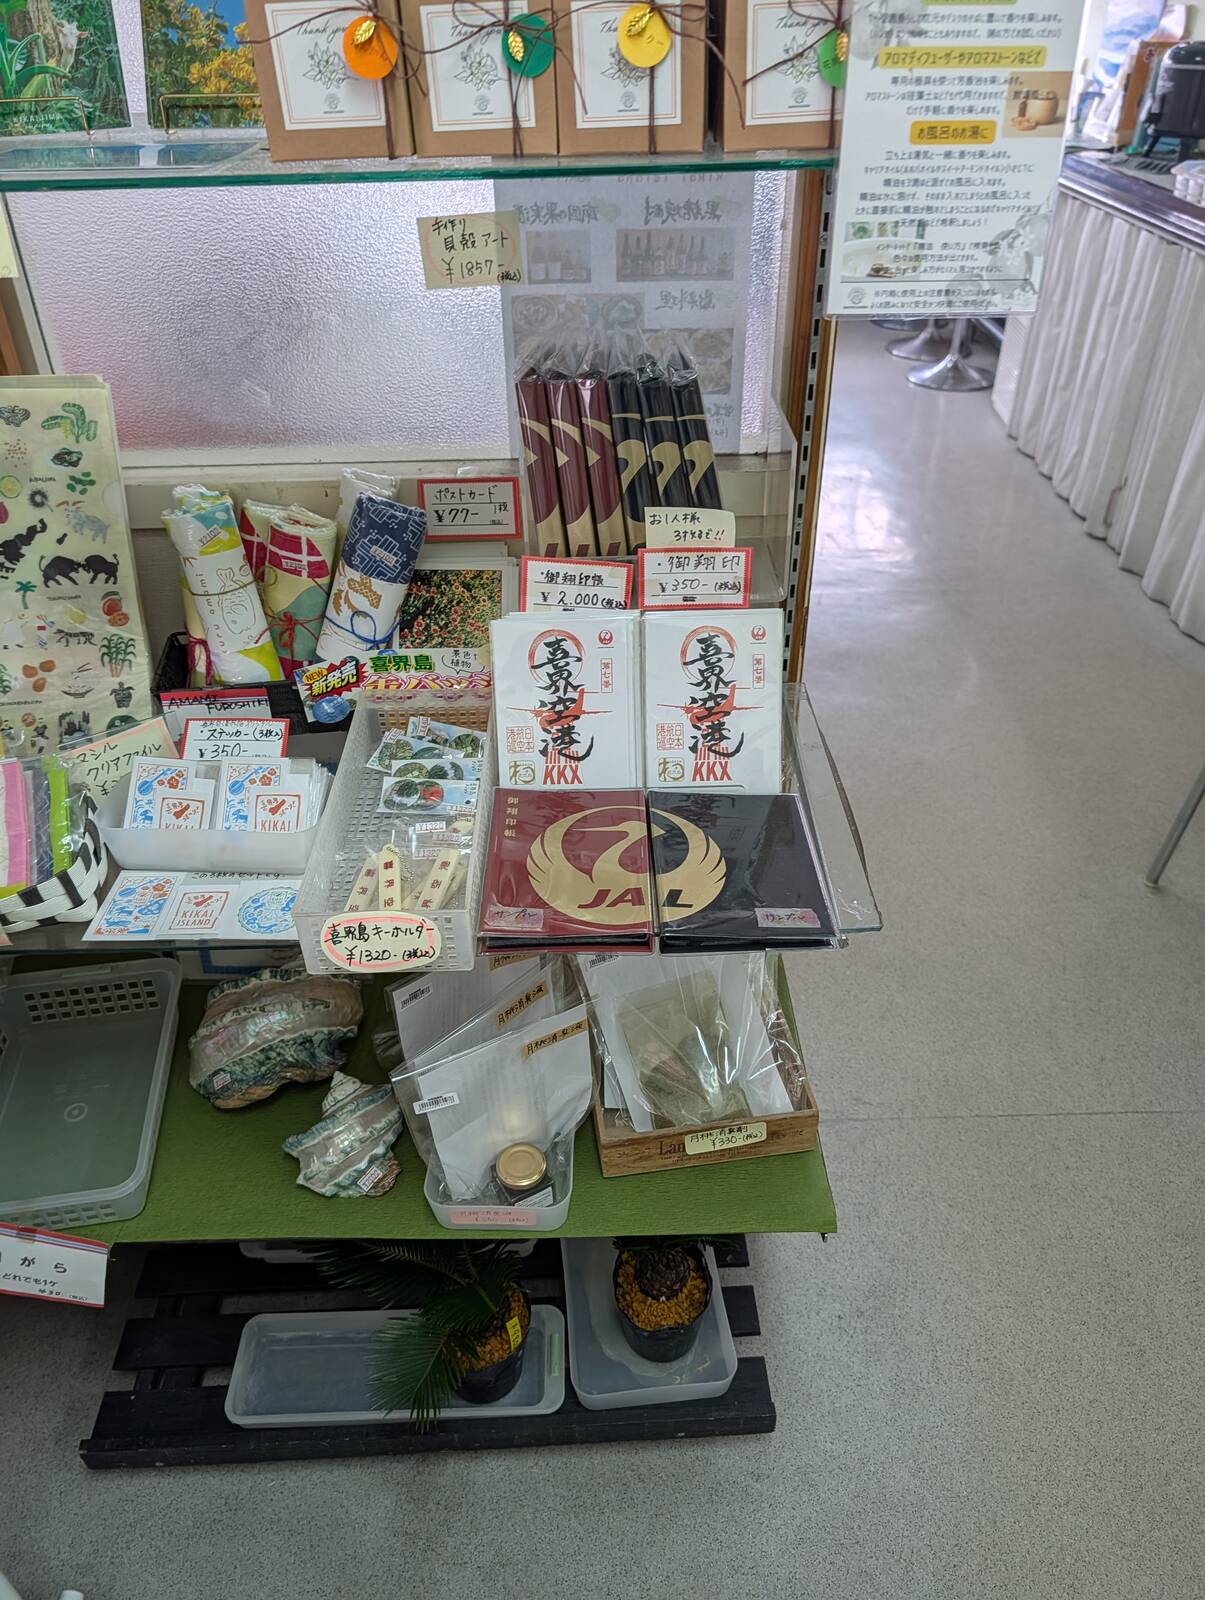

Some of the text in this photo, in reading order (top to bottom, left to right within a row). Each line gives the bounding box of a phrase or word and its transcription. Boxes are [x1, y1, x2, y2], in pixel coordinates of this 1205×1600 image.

[917, 126, 988, 140] お風呂のお湯に
[432, 218, 466, 236] 手作り
[435, 485, 498, 502] ポストカード
[369, 654, 435, 672] 喜界島
[305, 669, 325, 682] NEW
[312, 660, 357, 696] 新発売
[531, 636, 594, 761] 喜界空港
[683, 632, 745, 758] 喜界空港
[542, 762, 583, 785] KKX
[692, 760, 733, 783] KKX
[260, 820, 291, 832] KIKAI
[177, 918, 210, 926] ISLAND
[181, 910, 214, 919] KIKAI
[324, 918, 434, 945] 喜界島キーホルダー
